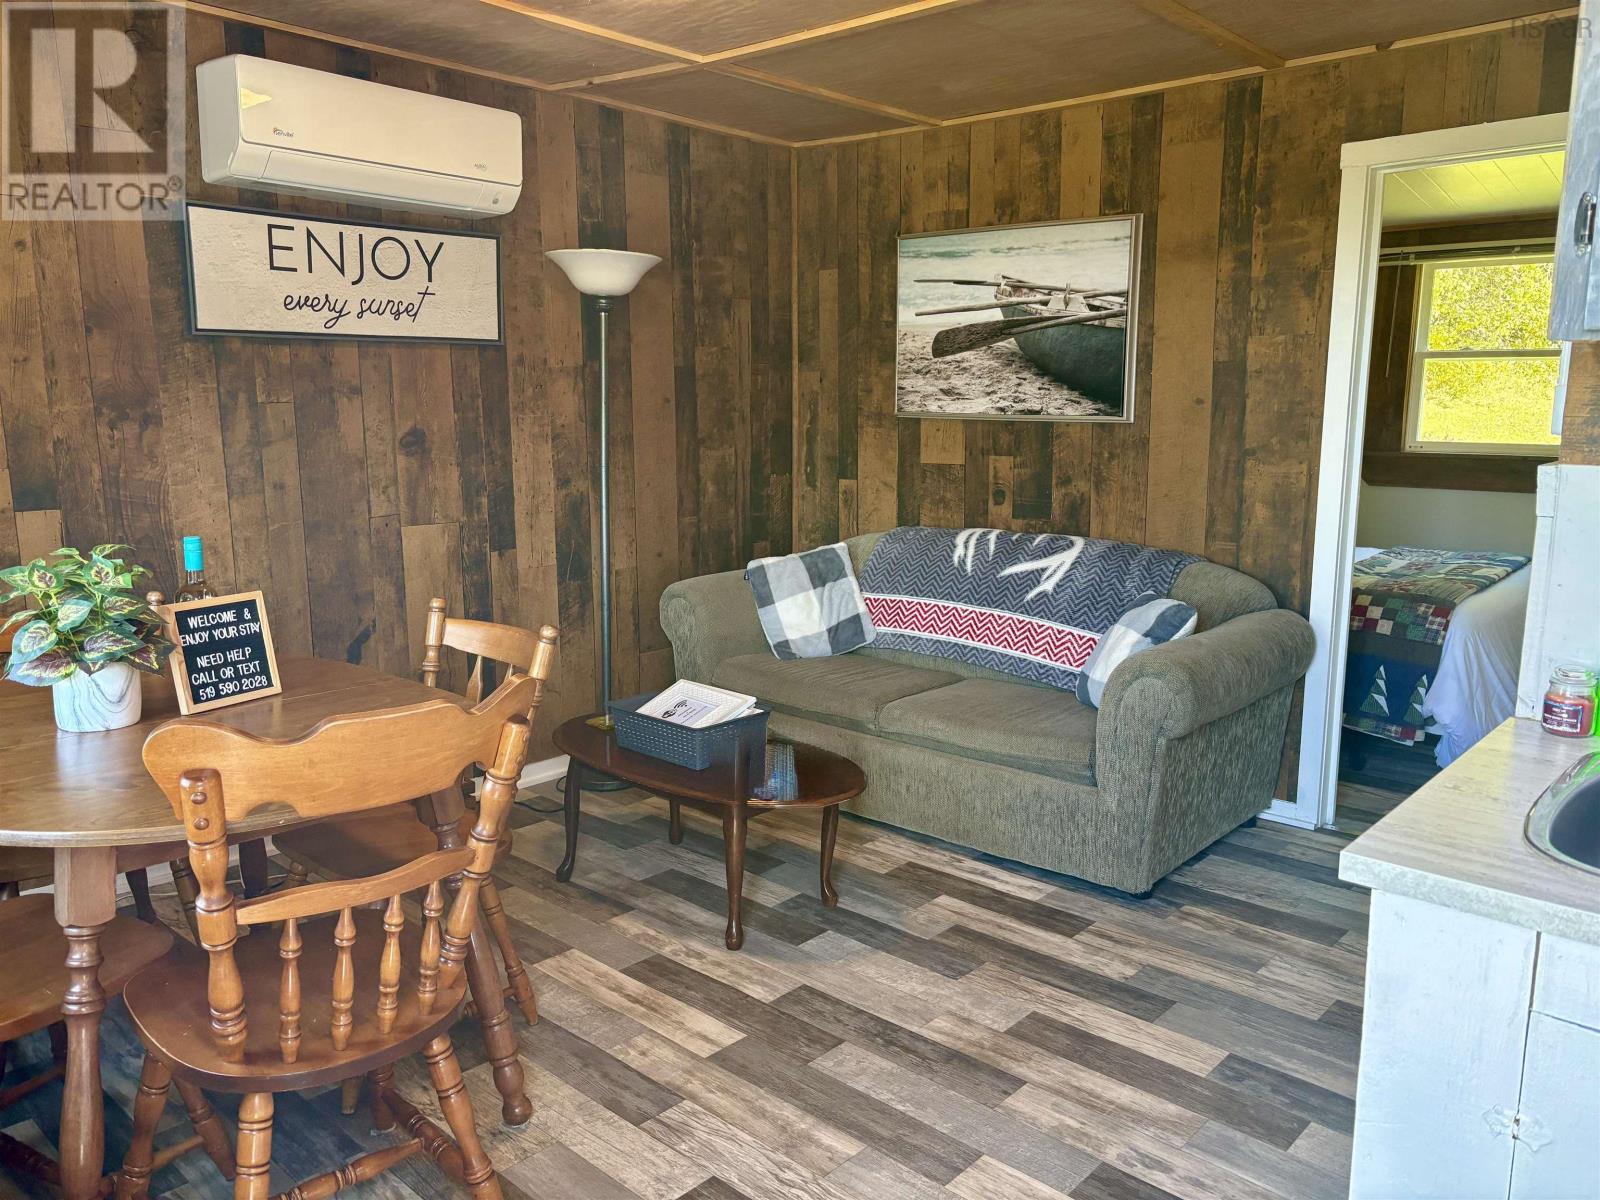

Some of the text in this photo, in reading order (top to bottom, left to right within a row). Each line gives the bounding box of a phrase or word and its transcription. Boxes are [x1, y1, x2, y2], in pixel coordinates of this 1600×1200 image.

[267, 223, 444, 285] ENJOY
[283, 285, 436, 329] every sunset
[187, 608, 252, 629] WELCOME &
[179, 622, 260, 647] ENJOY YOUR STAY
[196, 647, 252, 669] NEED HELP
[191, 660, 260, 685] CALL OR TEXT
[199, 675, 268, 700] 519 590 2028
